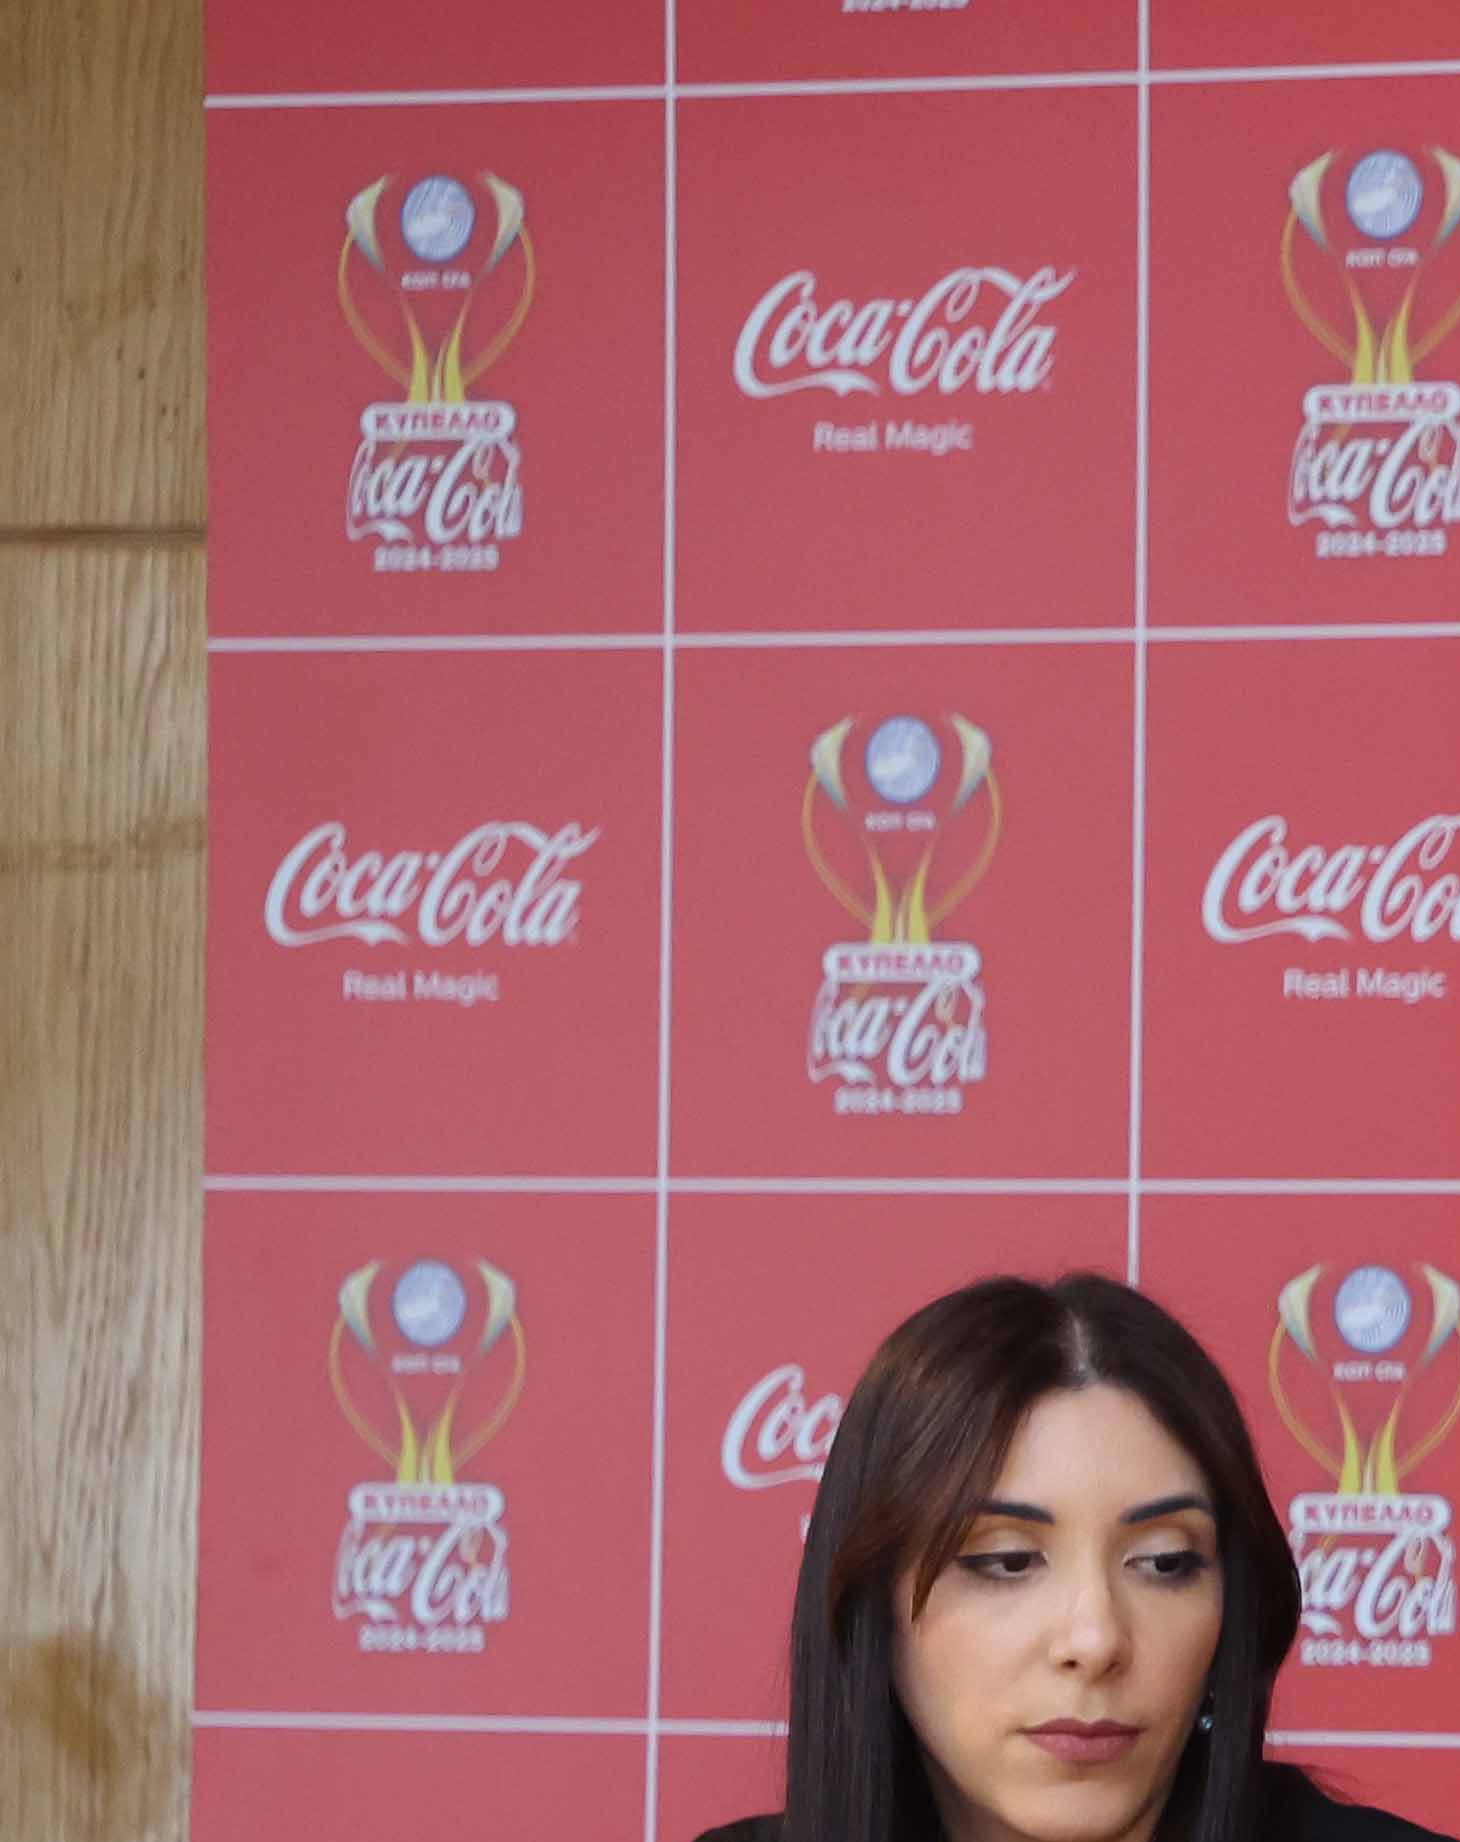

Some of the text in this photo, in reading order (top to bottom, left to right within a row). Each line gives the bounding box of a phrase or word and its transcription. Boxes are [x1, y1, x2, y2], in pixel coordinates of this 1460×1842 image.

[734, 267, 1073, 397] Coca-Cola
[814, 421, 972, 455] Real Magic
[265, 822, 600, 946] Coca-Cola
[1283, 968, 1445, 1003] Real Magic
